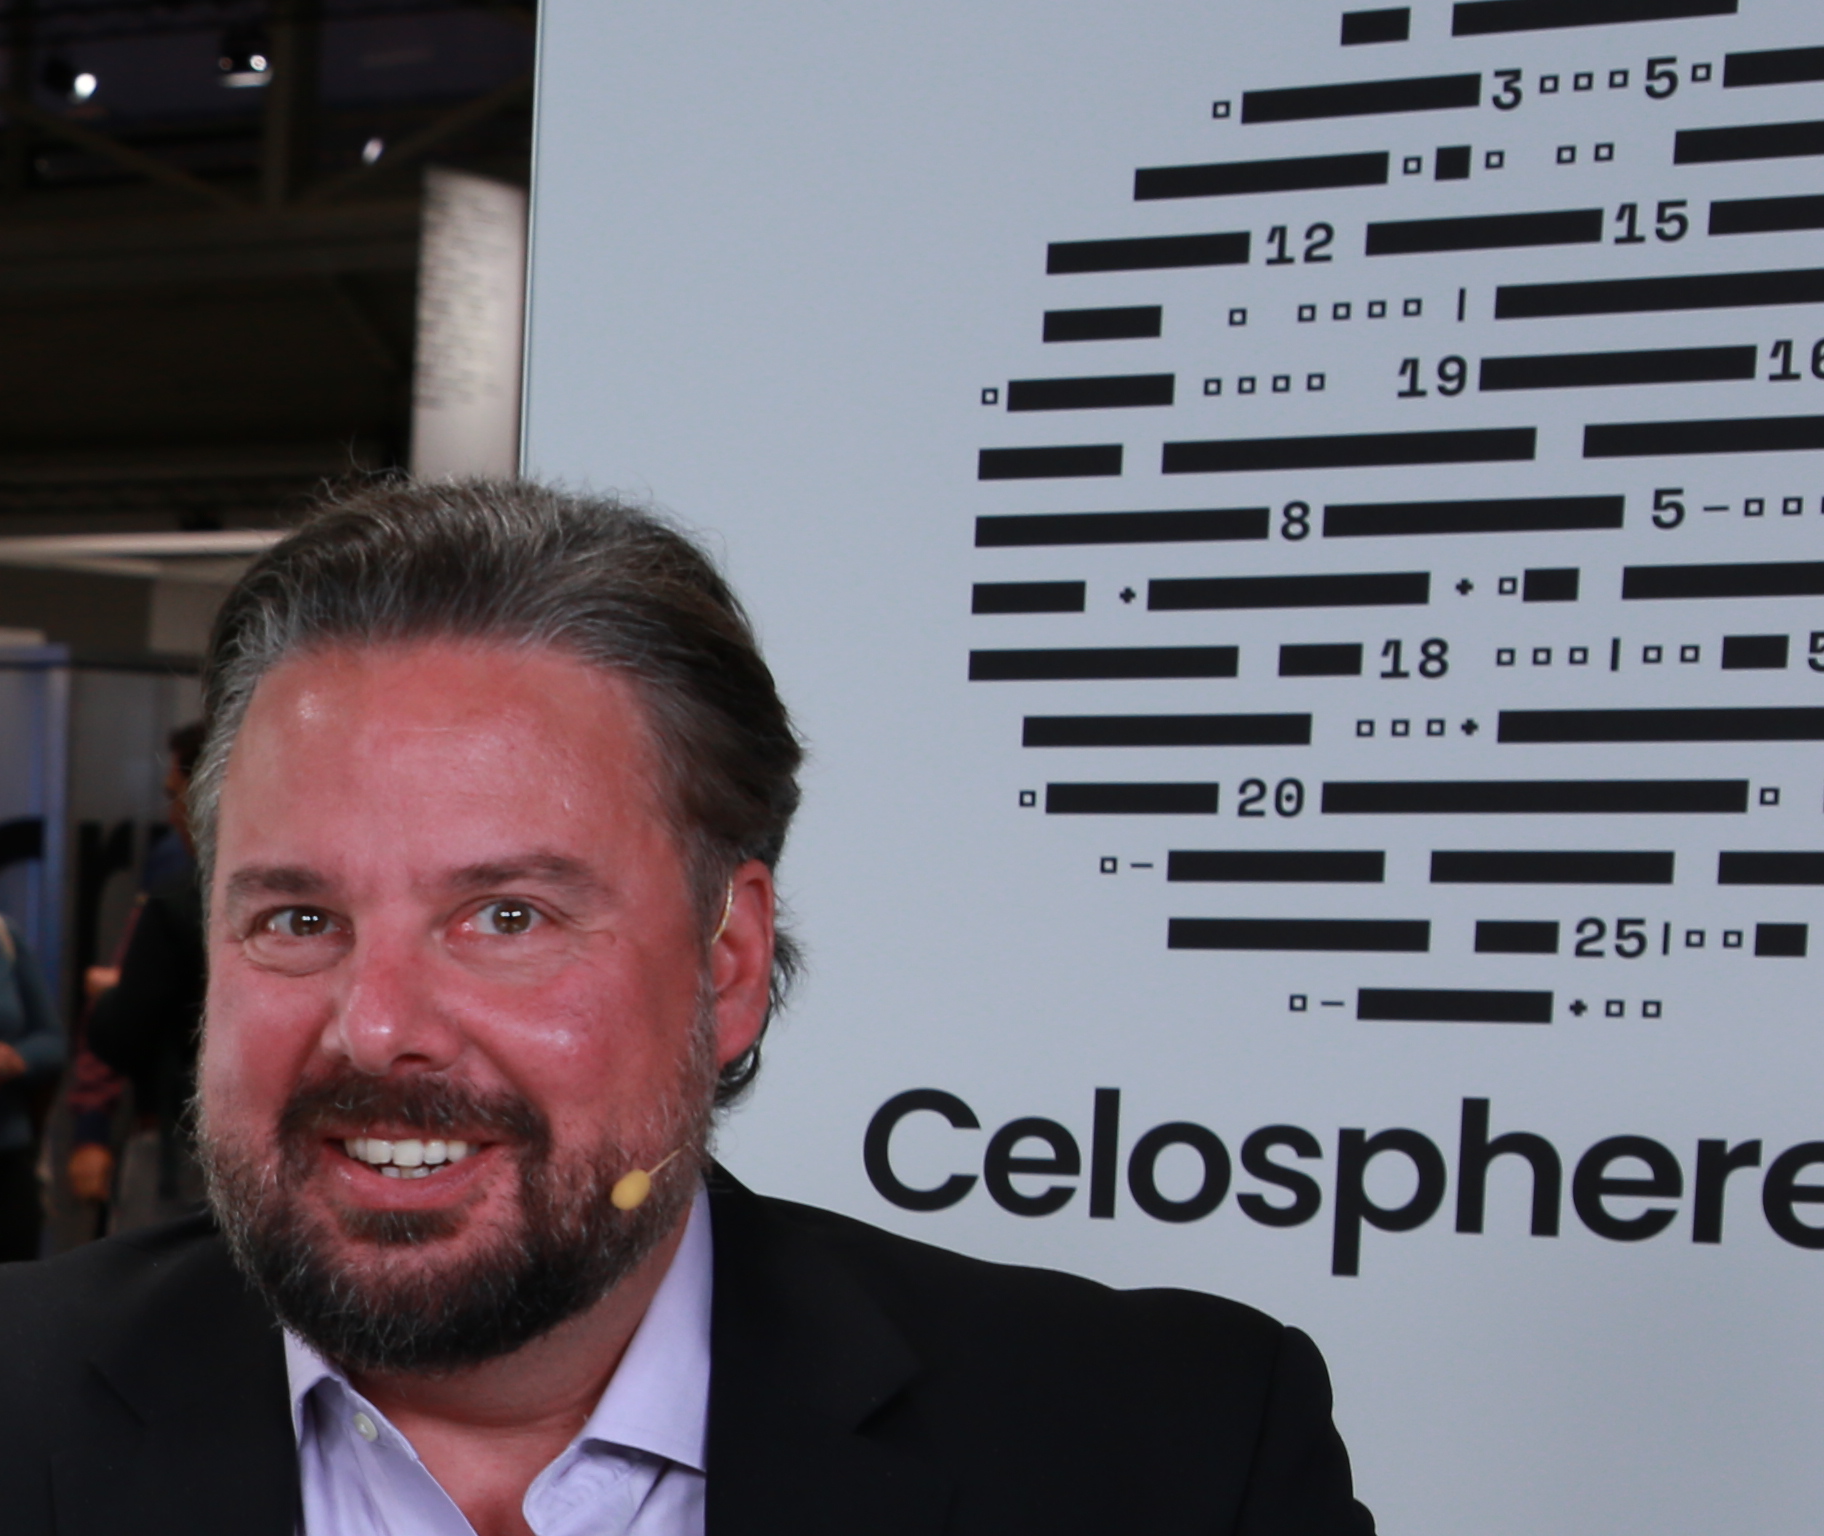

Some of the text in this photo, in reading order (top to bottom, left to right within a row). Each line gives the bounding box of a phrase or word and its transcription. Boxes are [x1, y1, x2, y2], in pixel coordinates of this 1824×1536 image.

[1264, 200, 1690, 265] 12 15
[1397, 355, 1468, 398] 19
[1280, 501, 1312, 542] 8
[1379, 638, 1450, 679] 18
[1237, 778, 1306, 818] 20
